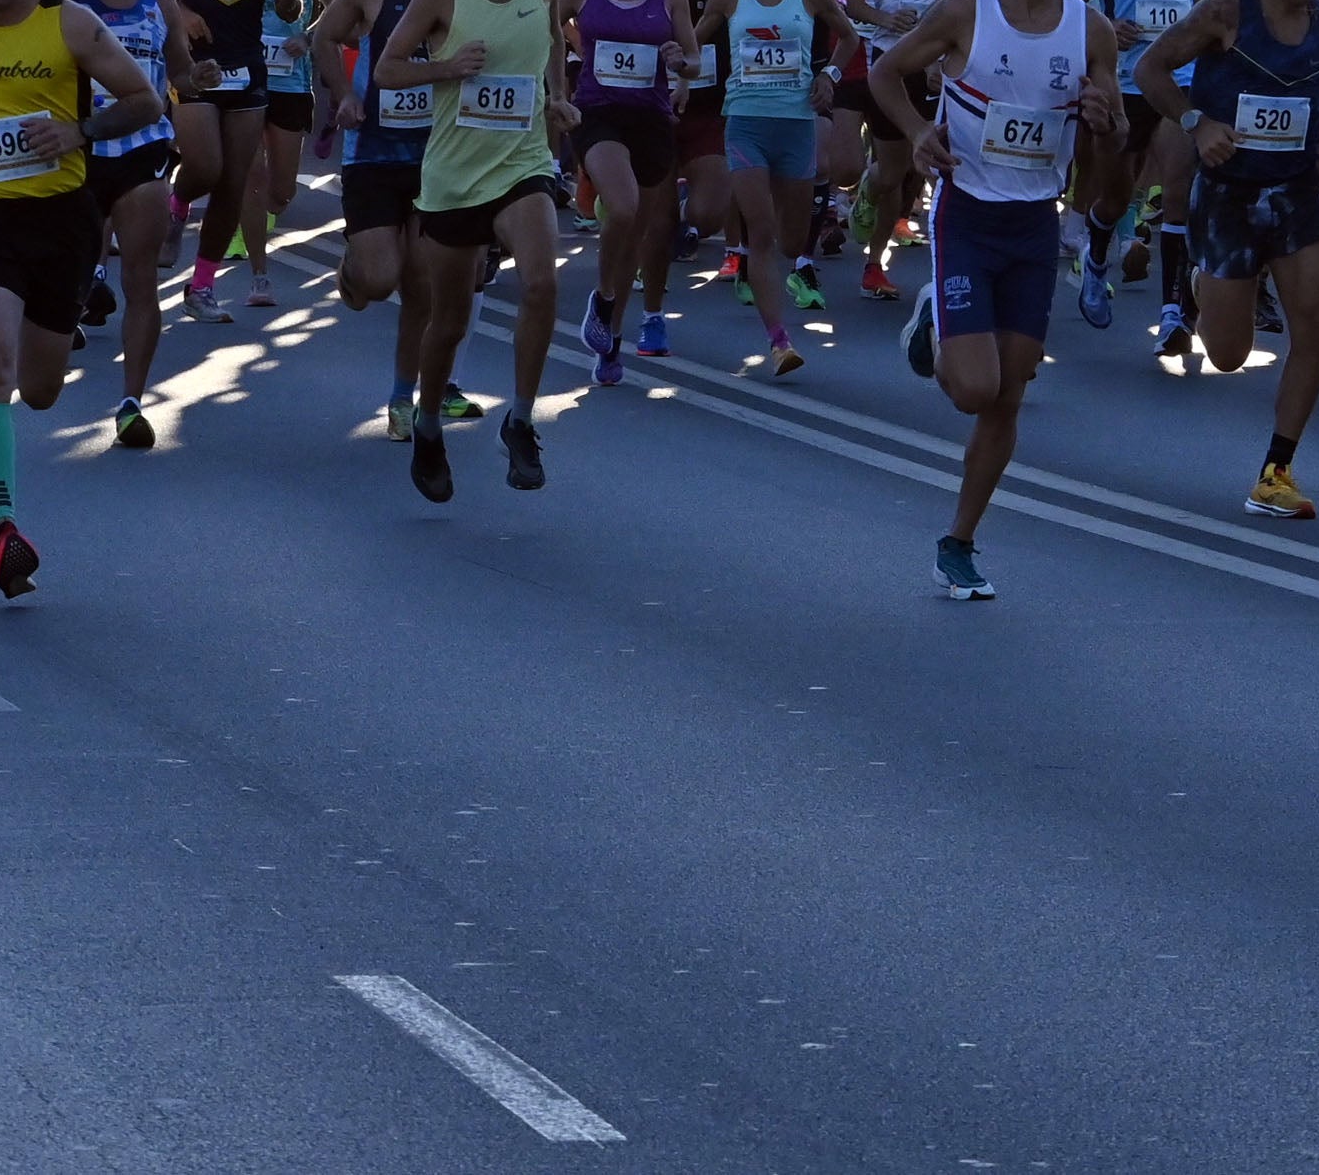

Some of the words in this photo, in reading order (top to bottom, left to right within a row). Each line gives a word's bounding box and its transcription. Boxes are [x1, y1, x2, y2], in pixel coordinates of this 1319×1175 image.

[1150, 8, 1178, 25] 110
[614, 52, 635, 71] 94
[754, 48, 786, 66] 413
[394, 92, 427, 110] 238
[478, 87, 515, 110] 618
[1254, 108, 1291, 131] 520
[1004, 119, 1044, 146] 674
